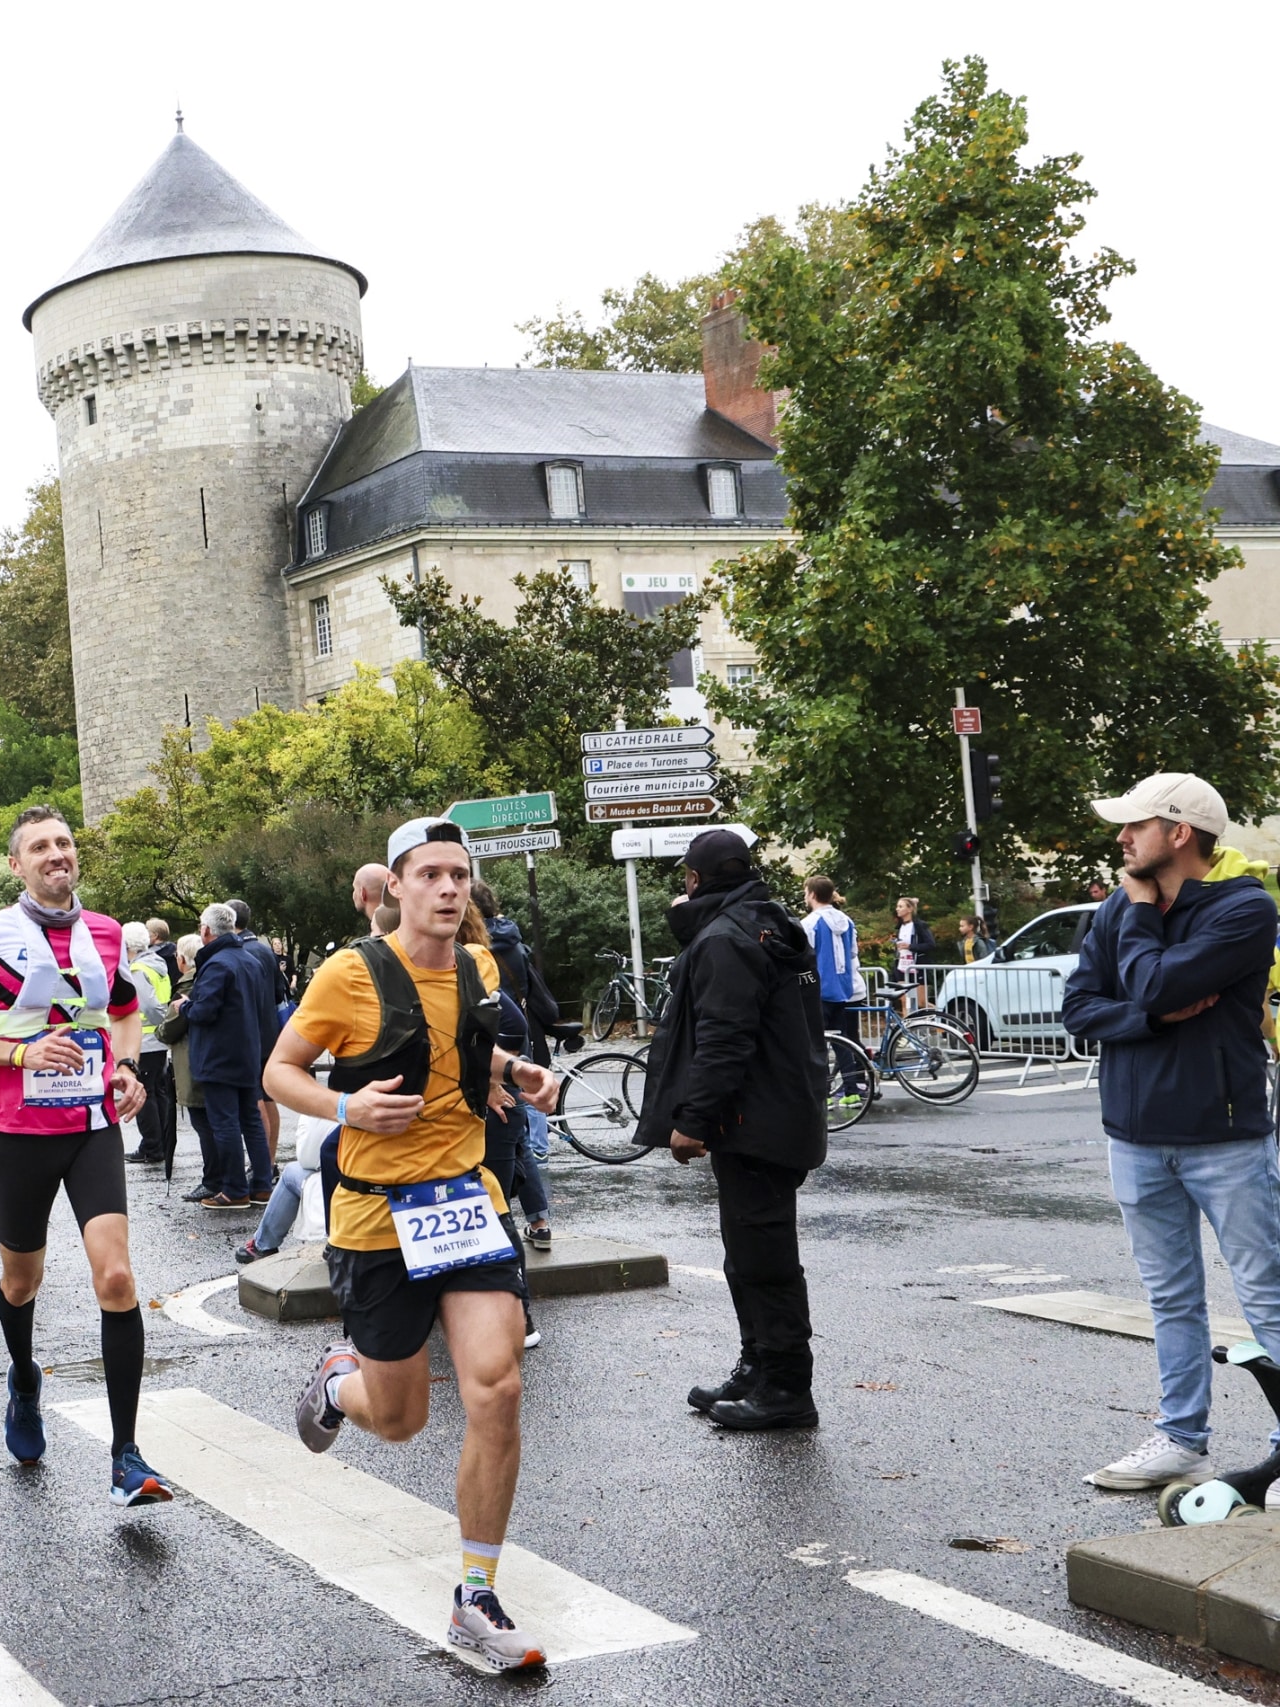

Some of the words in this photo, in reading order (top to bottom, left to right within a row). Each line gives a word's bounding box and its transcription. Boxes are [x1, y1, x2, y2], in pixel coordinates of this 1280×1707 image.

[648, 577, 667, 588] JEU
[679, 577, 693, 588] DE
[605, 732, 683, 747] CATHÉDRALE
[606, 759, 633, 770] Place
[634, 760, 648, 768] des
[651, 757, 688, 768] Turones
[592, 783, 640, 795] fourrière
[645, 778, 705, 793] municipale
[491, 801, 527, 812] TOUTES
[609, 807, 636, 817] Musée
[637, 805, 651, 815] des
[652, 802, 682, 814] Beaux
[684, 801, 705, 812] Arts
[492, 809, 548, 824] DIRECTIONS
[495, 835, 550, 851] TROUSSEAU
[51, 1080, 82, 1088] ANDREA
[407, 1205, 488, 1242] 22325
[433, 1238, 480, 1254] MATTHIEU
